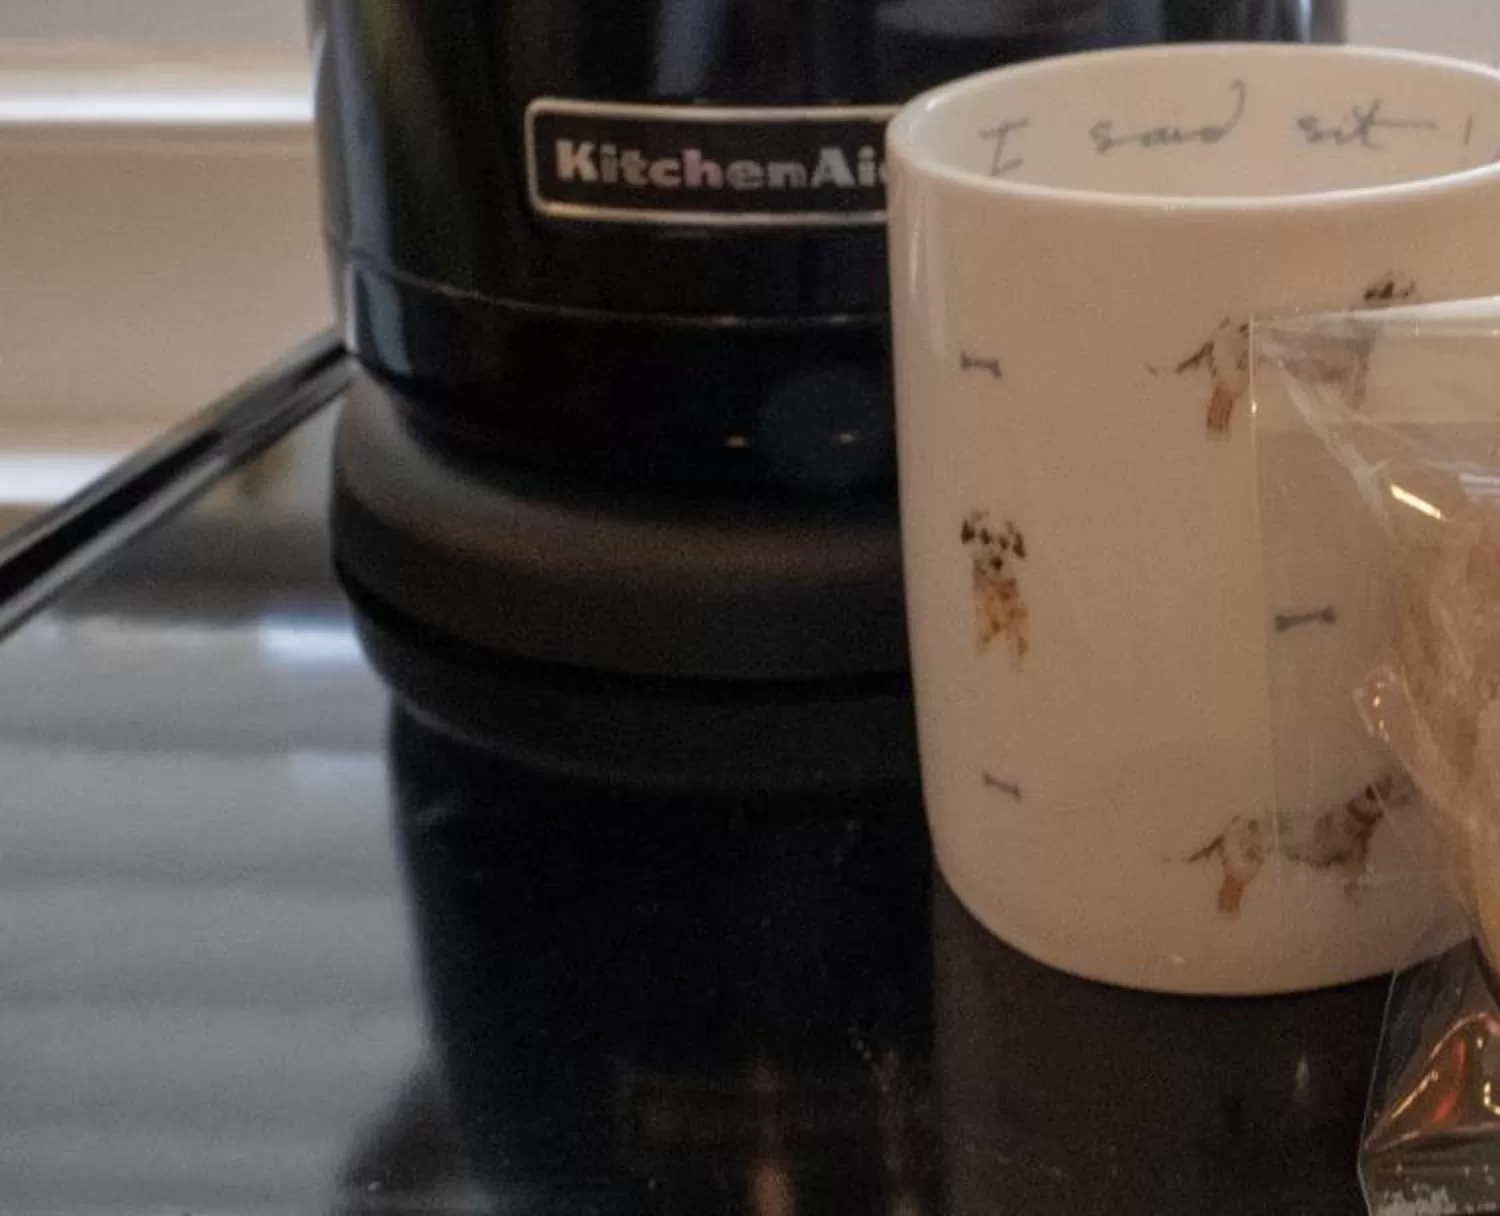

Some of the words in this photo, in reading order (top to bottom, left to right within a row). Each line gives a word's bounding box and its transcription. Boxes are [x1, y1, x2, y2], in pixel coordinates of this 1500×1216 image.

[978, 117, 1029, 176] I
[1088, 76, 1247, 155] said
[554, 139, 888, 189] KitchenAi
